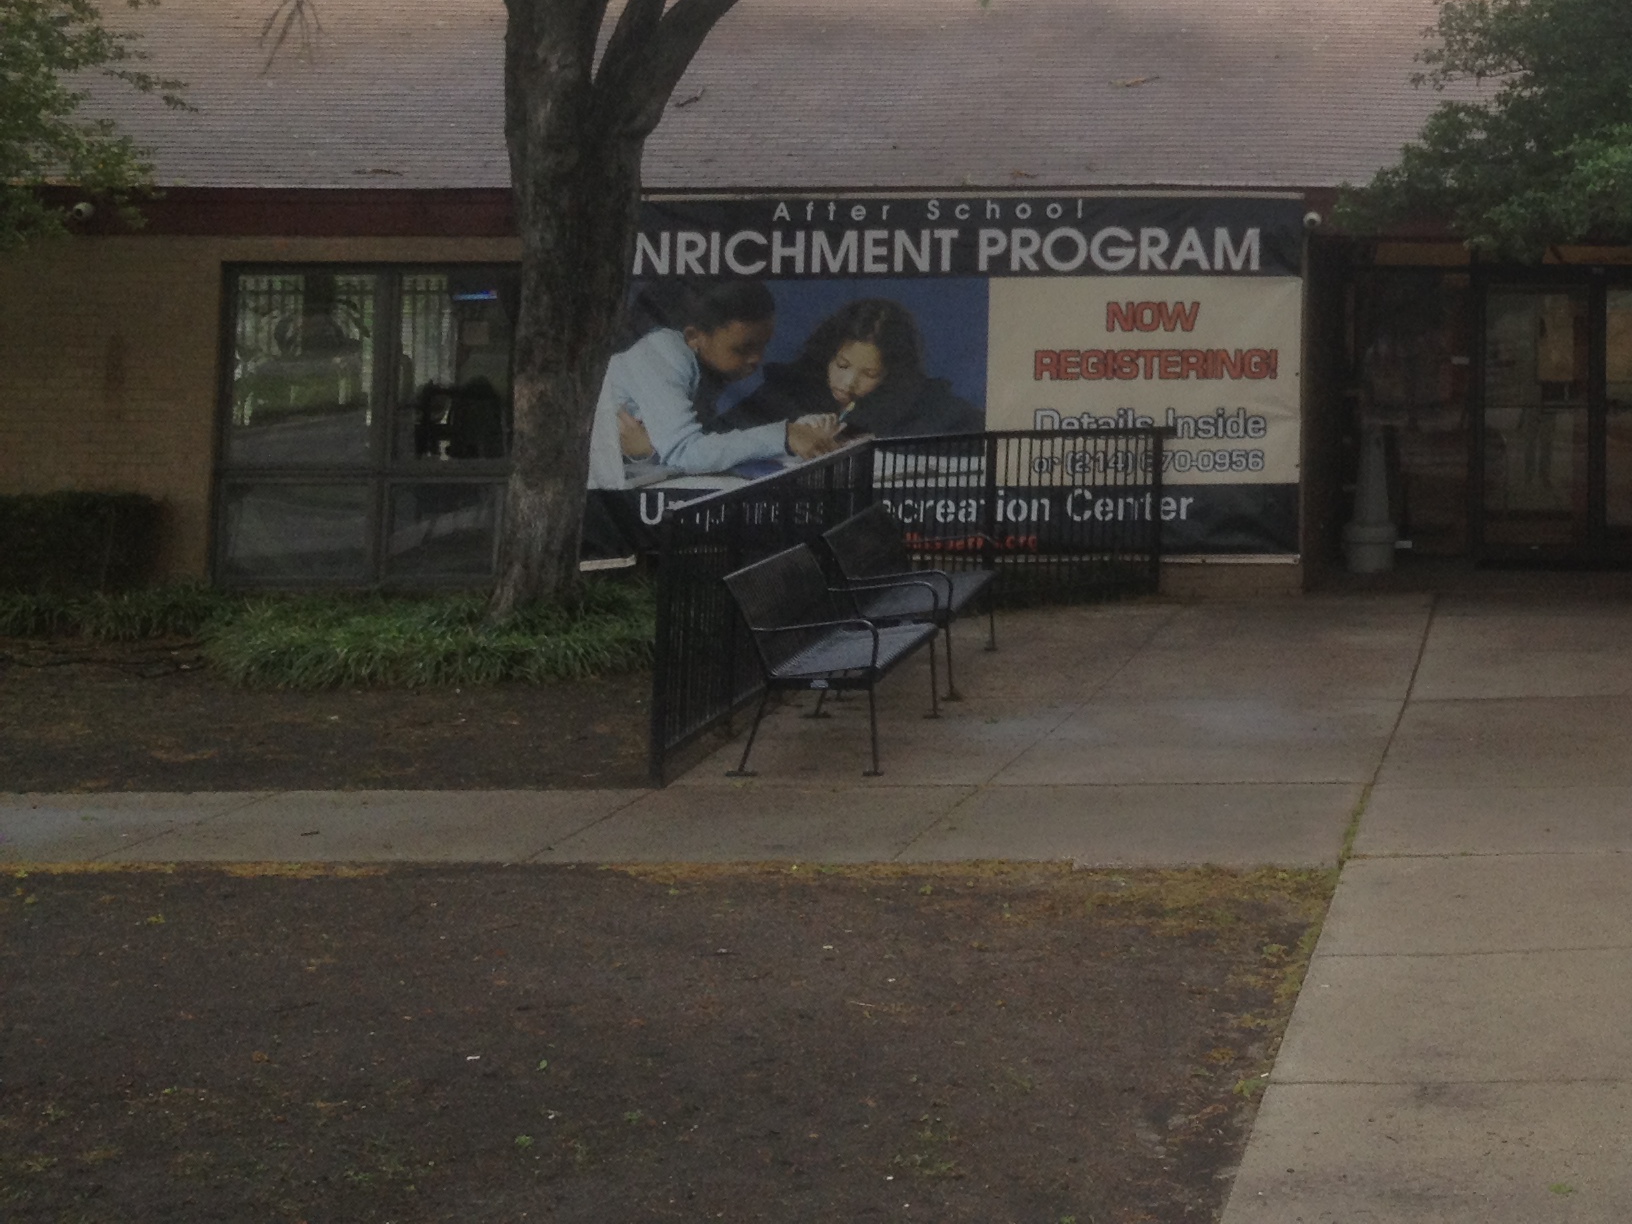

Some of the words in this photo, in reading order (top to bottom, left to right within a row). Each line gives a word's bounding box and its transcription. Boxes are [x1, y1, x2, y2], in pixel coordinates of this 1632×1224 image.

[772, 200, 891, 223] After
[927, 199, 1085, 222] School
[632, 228, 959, 278] NRICHMENT
[977, 227, 1262, 273] PROGRAM
[1106, 301, 1200, 333] NOW
[1033, 349, 1279, 381] REGISTERING!
[1033, 407, 1155, 438] Details
[1165, 406, 1268, 439] Inside
[882, 488, 1051, 524] creaion
[1066, 487, 1196, 522] Center
